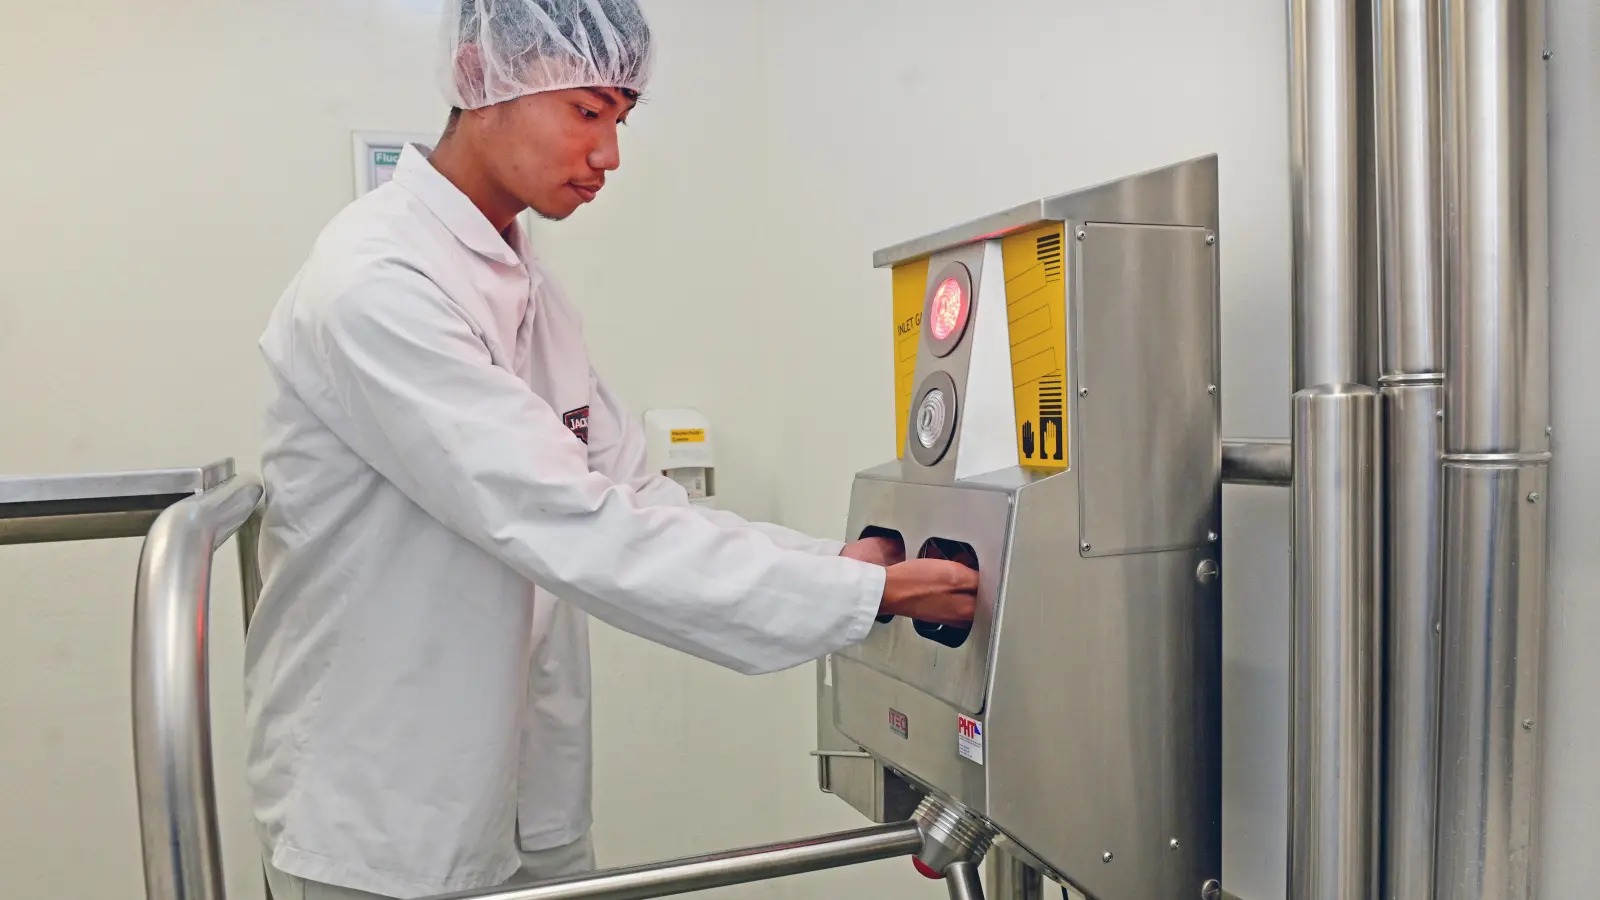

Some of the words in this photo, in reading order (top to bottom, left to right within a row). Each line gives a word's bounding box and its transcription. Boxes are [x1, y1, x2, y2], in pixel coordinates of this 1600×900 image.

[897, 317, 914, 336] INLET
[889, 710, 908, 732] ITEC
[958, 716, 975, 739] PHT
